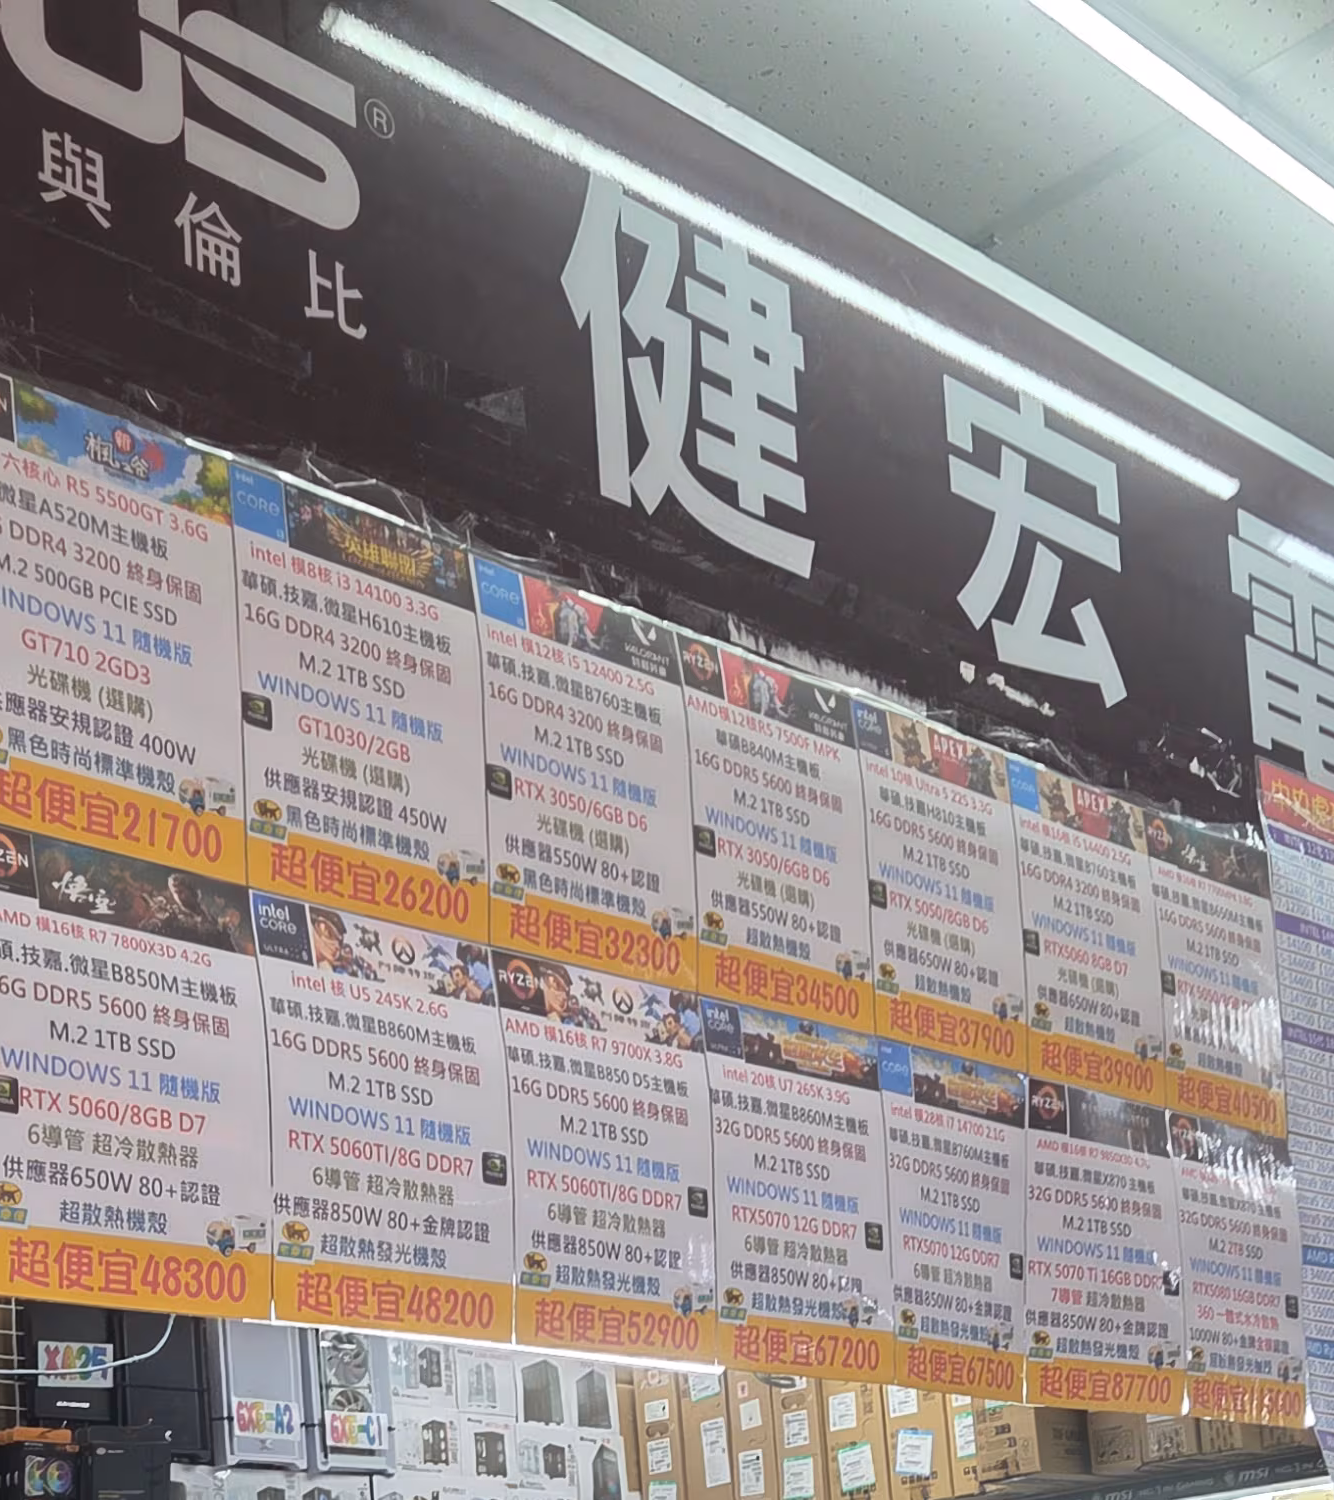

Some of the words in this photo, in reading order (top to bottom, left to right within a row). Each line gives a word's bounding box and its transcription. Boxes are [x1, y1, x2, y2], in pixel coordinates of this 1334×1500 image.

[2, 451, 61, 490] 六核心
[67, 476, 90, 498] R5
[96, 486, 165, 528] 5500GT
[168, 515, 209, 542] 3.6G
[21, 629, 90, 666] GT710
[95, 653, 151, 685] 2GD3
[514, 777, 546, 803] RTX
[549, 788, 624, 826] 3050/6GB
[628, 809, 648, 832] D6
[271, 843, 469, 925] 超便宜26200
[717, 839, 744, 861] RTX
[746, 848, 810, 879] 3050/6GB
[813, 865, 830, 887] D6
[889, 890, 913, 911] RTX
[510, 904, 681, 976] 超便宜32300
[714, 952, 860, 1020] 超便宜34500
[889, 999, 1014, 1057] 超便宜37900
[1040, 1039, 1154, 1093] 超便宜39900
[19, 1086, 62, 1114] RTX
[68, 1097, 172, 1132] 5060/8GB
[178, 1113, 206, 1136] D7
[527, 1169, 558, 1192] RTX
[642, 1187, 682, 1210] DDR7
[731, 1206, 791, 1231] RTX5070
[793, 1216, 819, 1235] 12G
[822, 1220, 858, 1239] DDR7
[8, 1236, 247, 1303] 超便宜48300
[296, 1271, 494, 1330] 超便宜48200
[535, 1298, 699, 1352] 超便宜52900
[733, 1325, 880, 1371] 超便宜67200
[907, 1345, 1014, 1390] 超便宜67500
[1040, 1362, 1171, 1403] 超便宜87700
